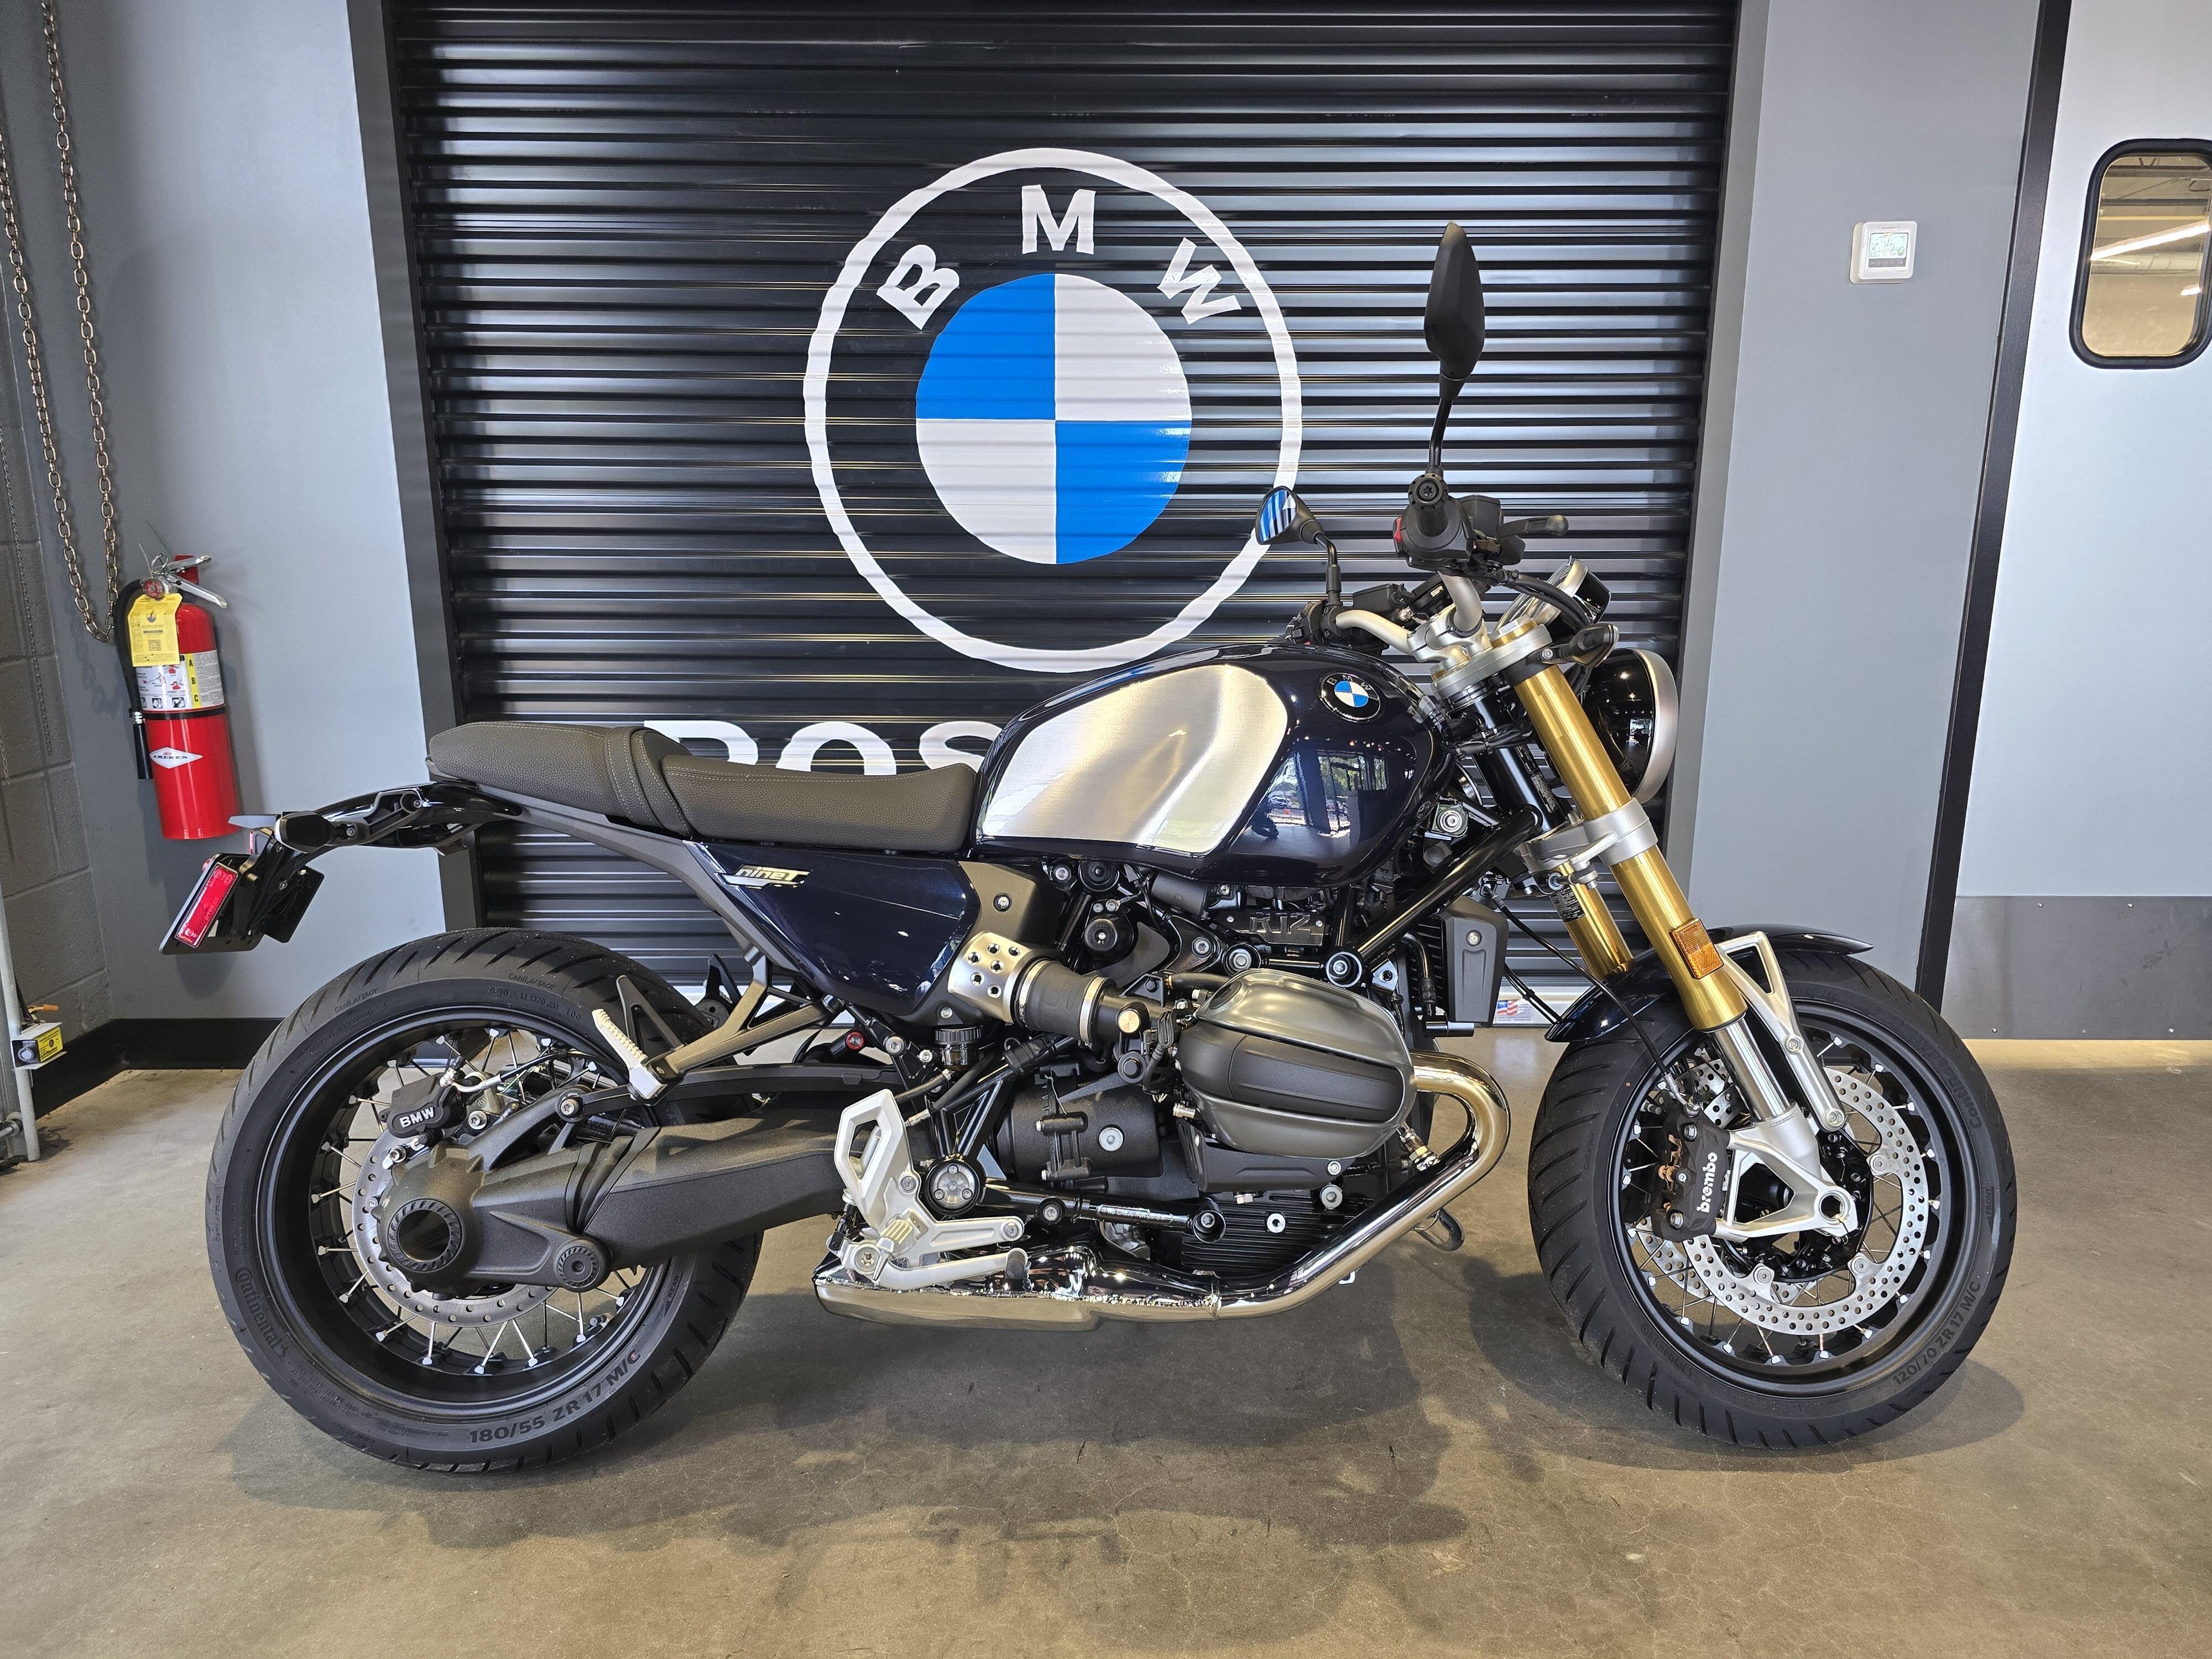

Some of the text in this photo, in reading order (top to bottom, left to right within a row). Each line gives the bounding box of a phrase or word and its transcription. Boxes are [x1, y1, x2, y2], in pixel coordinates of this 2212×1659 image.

[877, 184, 1241, 330] BMW
[1327, 675, 1371, 691] BMW
[1250, 912, 1311, 935] R12
[399, 1107, 434, 1128] BMW
[1696, 1152, 1718, 1213] brembo
[667, 1275, 680, 1298] REAR
[1892, 1347, 1938, 1385] 120/70
[1960, 1281, 1981, 1312] M/C
[469, 1415, 545, 1443] 180/55
[606, 1349, 641, 1386] M/C
